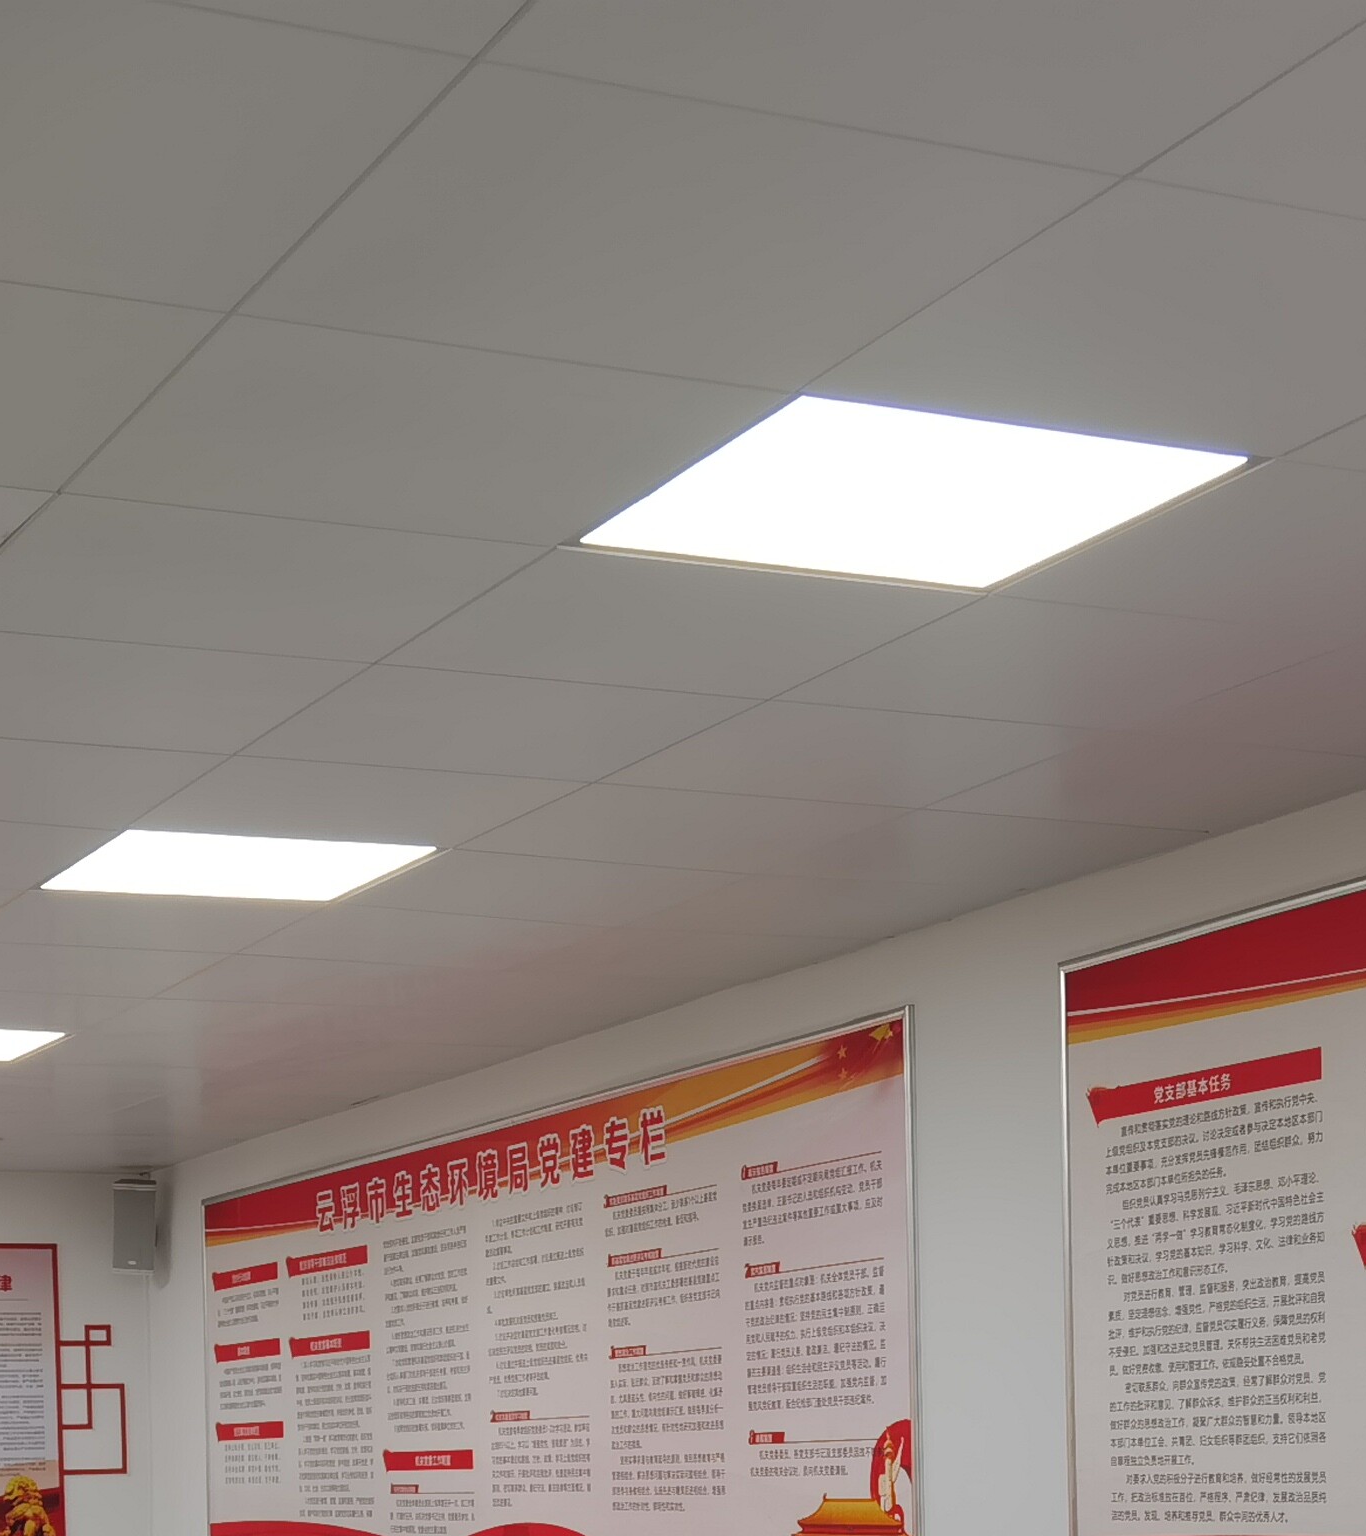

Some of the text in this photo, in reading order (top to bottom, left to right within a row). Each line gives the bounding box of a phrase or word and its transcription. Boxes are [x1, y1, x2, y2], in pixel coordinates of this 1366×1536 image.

[1154, 1073, 1231, 1104] 党支部基本任务
[315, 1106, 667, 1233] 云浮市生态环境局党建专栏
